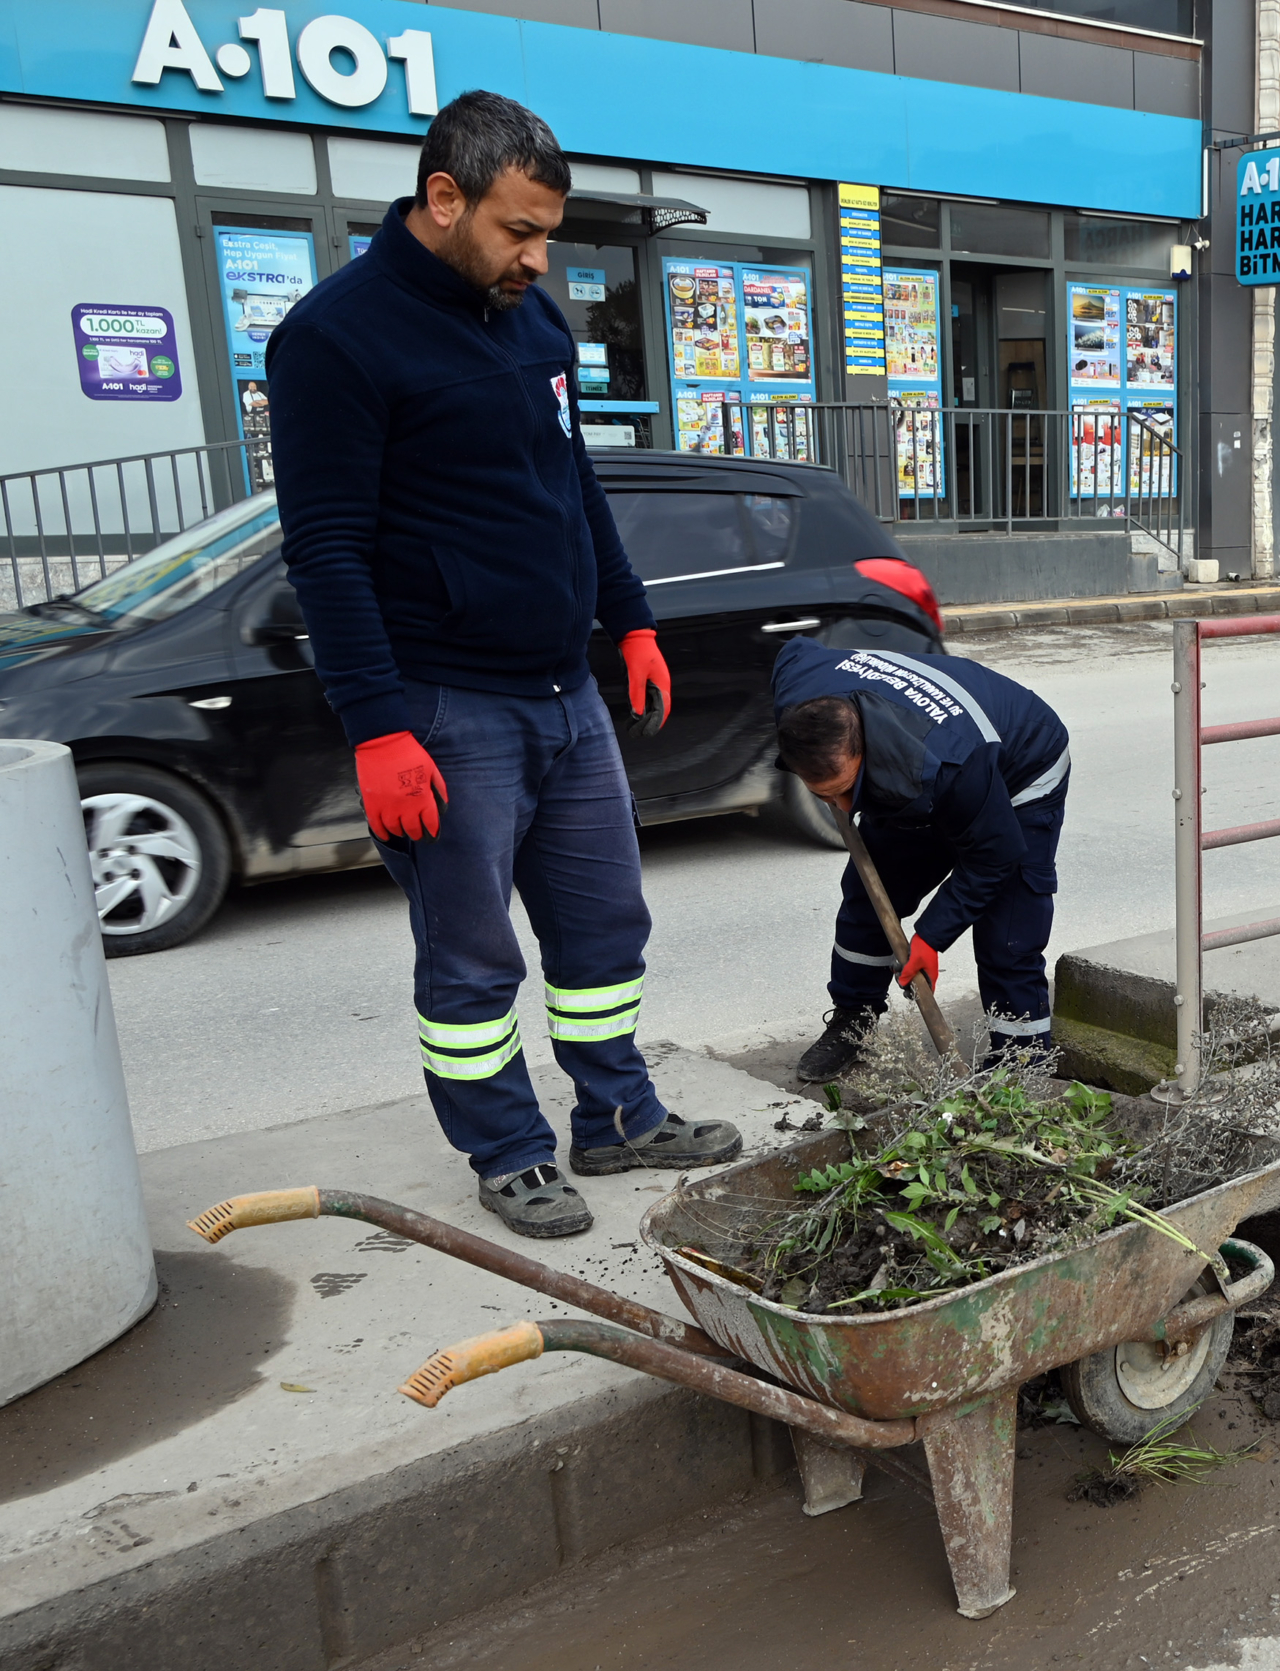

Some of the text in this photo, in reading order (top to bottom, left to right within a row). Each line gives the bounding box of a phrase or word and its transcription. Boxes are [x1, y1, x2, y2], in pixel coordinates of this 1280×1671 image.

[222, 239, 278, 251] Ekstra Çeşit,
[223, 248, 298, 261] Hep Uygun Fiyat
[577, 271, 595, 281] GİRİŞ
[743, 286, 773, 294] DARDANEL
[86, 318, 135, 334] 1.000
[135, 327, 163, 335] kazan!
[129, 349, 144, 358] hadi
[129, 383, 147, 392] hadi
[834, 659, 949, 725] YALOVA BELEDİYESİ
[938, 697, 954, 708] VE
[948, 704, 964, 717] SU
